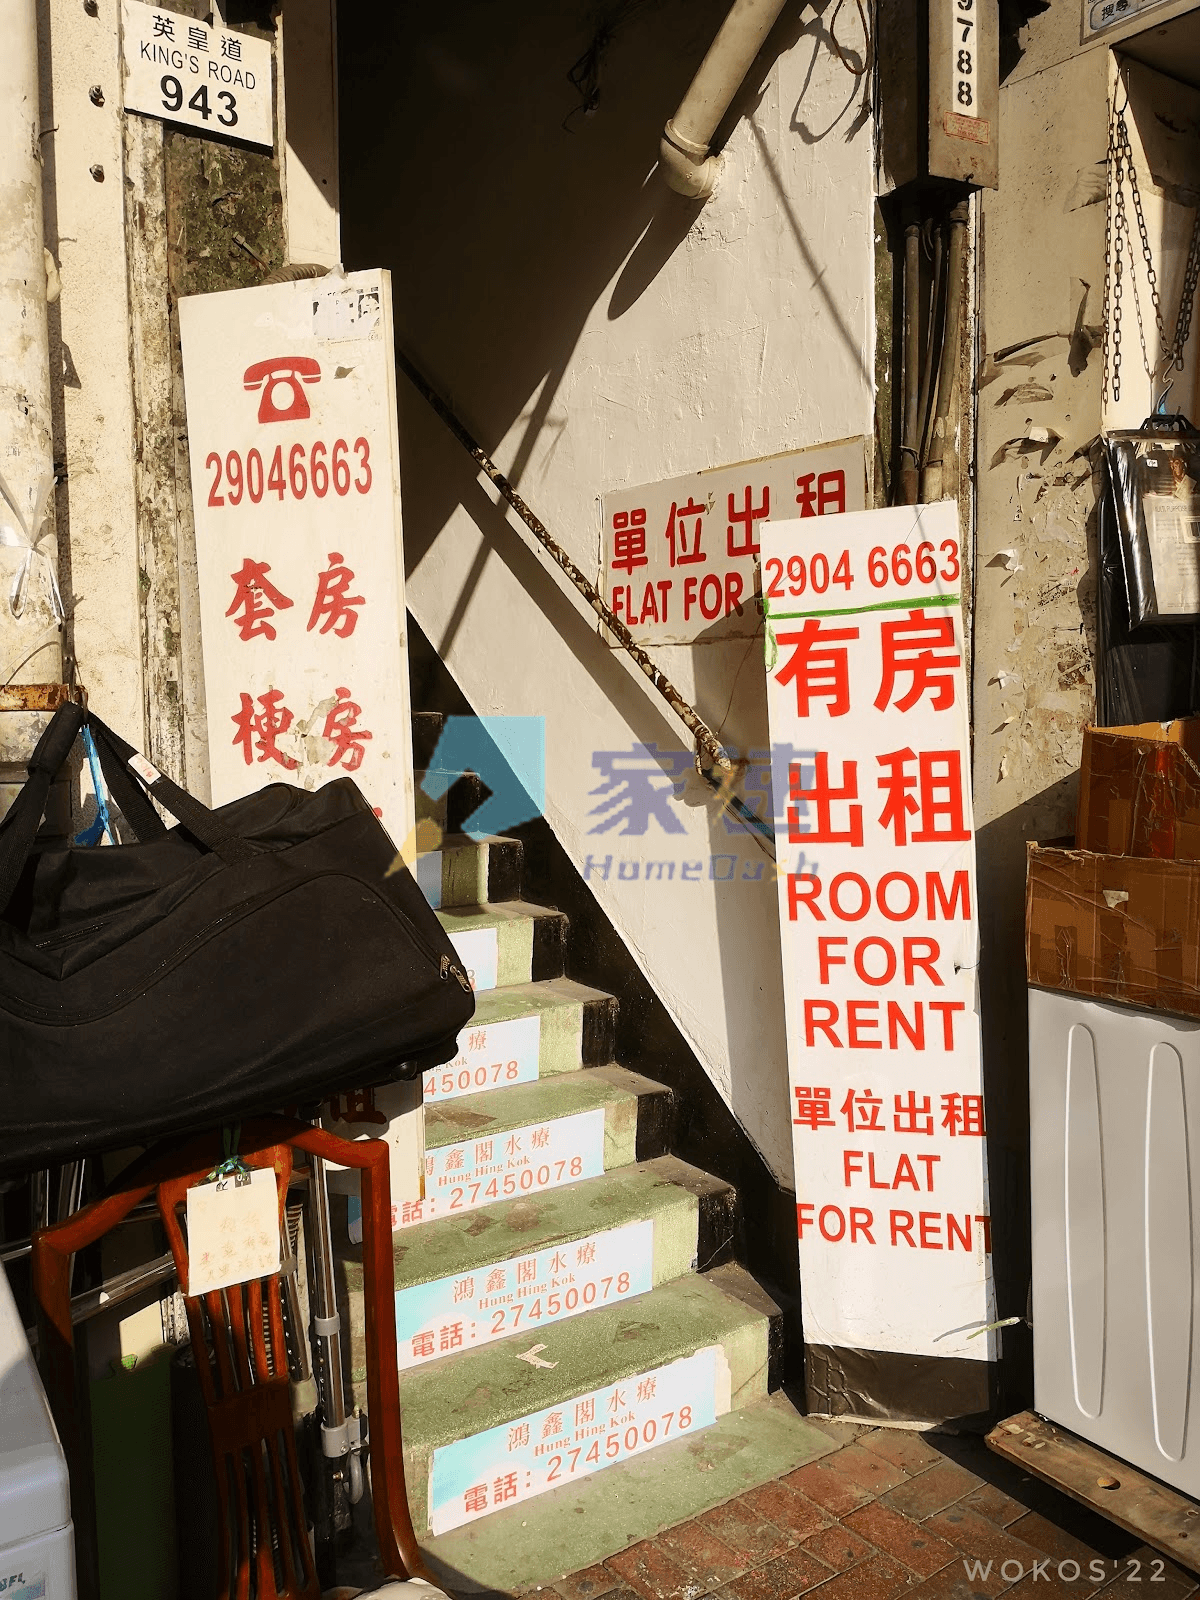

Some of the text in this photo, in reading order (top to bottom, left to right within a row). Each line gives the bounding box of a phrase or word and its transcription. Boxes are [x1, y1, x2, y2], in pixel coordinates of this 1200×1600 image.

[140, 40, 256, 90] KING'S ROAD
[152, 14, 242, 62] 英皇道
[160, 74, 239, 127] 943
[205, 436, 373, 508] 29046663
[765, 538, 960, 599] 2904 6663
[225, 551, 367, 642] 套房
[612, 571, 744, 626] FLAT FOR
[774, 608, 961, 718] 有房
[230, 686, 373, 772] 梗房
[787, 746, 972, 848] 出租
[787, 870, 972, 922] ROOM
[818, 935, 946, 987] FOR
[803, 998, 966, 1052] RENT
[793, 1086, 987, 1138] 單位出租
[438, 1154, 532, 1188] Hung Hing Kok
[450, 1155, 583, 1210] 27450078
[842, 1149, 941, 1193] FLAT
[796, 1202, 992, 1254] FOR RENT
[452, 1241, 597, 1304] 鴻鑫閣水療
[478, 1272, 576, 1310] Hung Hing Kok
[490, 1271, 631, 1335] 27450078
[507, 1376, 658, 1453] 鴻鑫閣水療
[533, 1410, 636, 1458] Hung Hing Kok
[546, 1405, 693, 1483] 27450078
